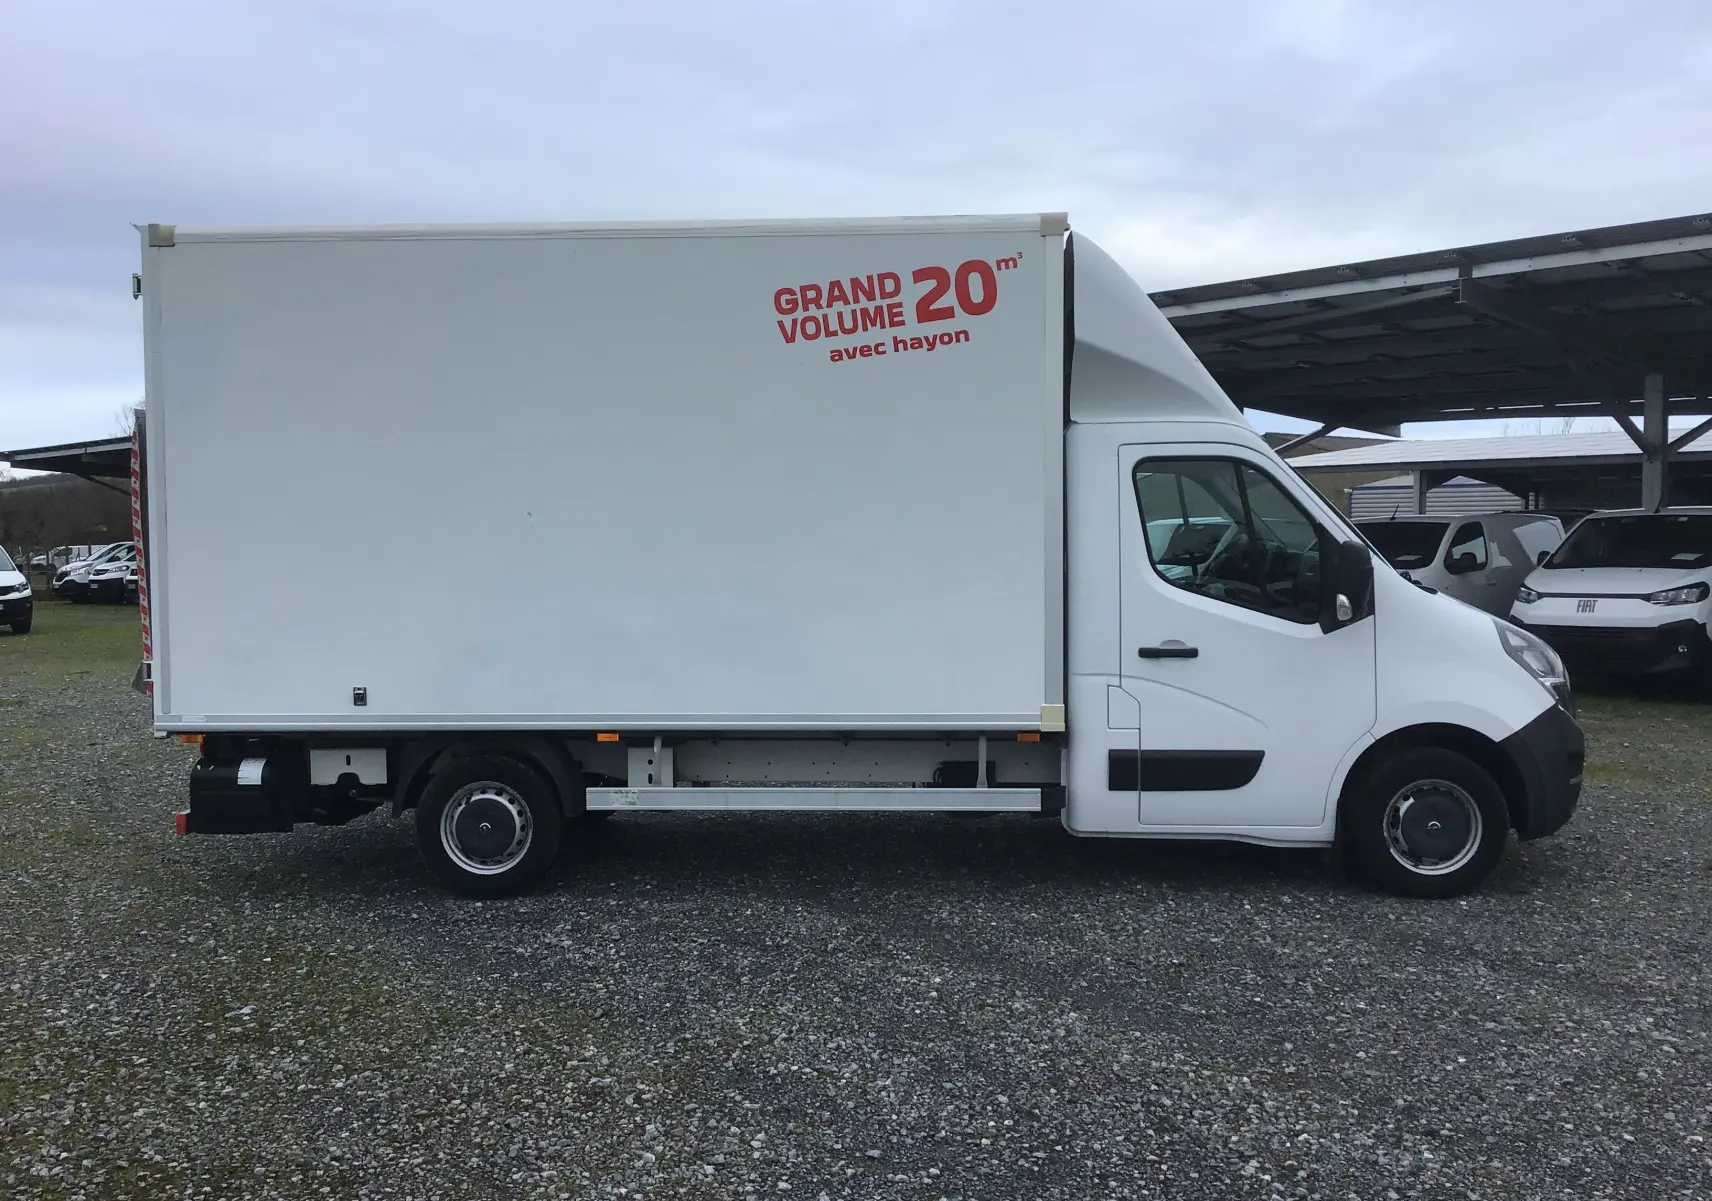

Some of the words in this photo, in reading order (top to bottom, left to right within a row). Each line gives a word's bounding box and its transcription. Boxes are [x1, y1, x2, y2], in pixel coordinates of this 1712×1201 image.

[773, 271, 902, 316] GRAND
[777, 301, 907, 344] VOLUME
[829, 340, 887, 363] avec
[892, 328, 970, 352] hayon
[1575, 599, 1598, 614] FIAT
